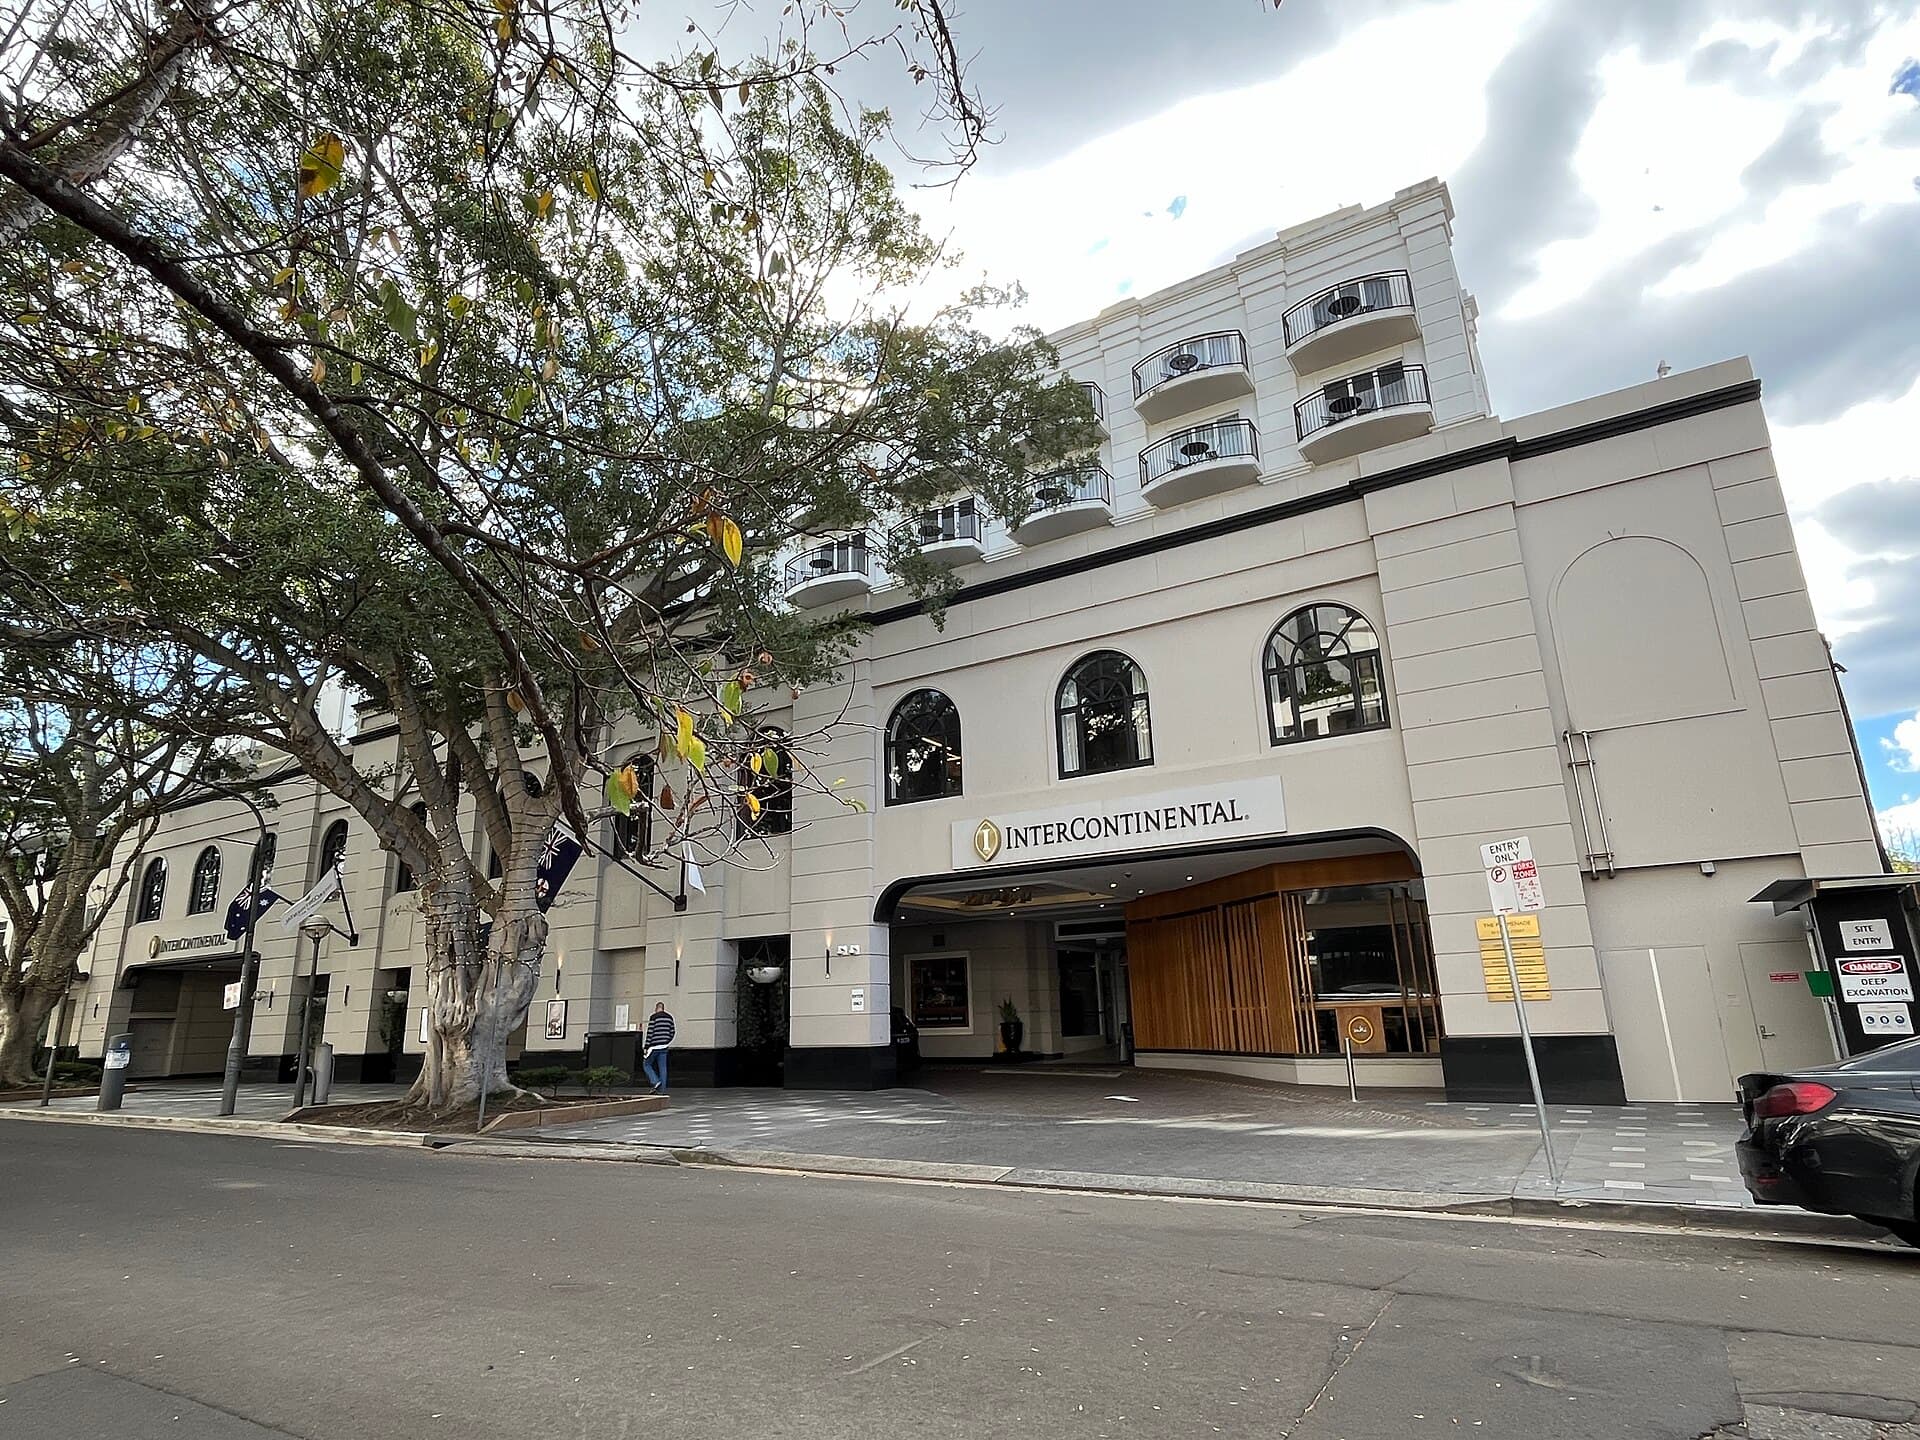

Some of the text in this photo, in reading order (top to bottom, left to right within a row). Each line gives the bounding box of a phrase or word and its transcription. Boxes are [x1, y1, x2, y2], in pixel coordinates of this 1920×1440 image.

[1005, 799, 1244, 850] INTERCONTINENTAL
[1489, 840, 1520, 855] ENTRY
[1495, 851, 1520, 864] ONLY
[1512, 861, 1534, 871] WORKS
[1513, 869, 1537, 879] ZONE
[1854, 925, 1874, 933] SITE
[1852, 936, 1882, 945] ENTRY
[1849, 961, 1893, 972] DANGER
[1860, 978, 1888, 986] DEEP
[1846, 988, 1909, 997] EXCAVATION
